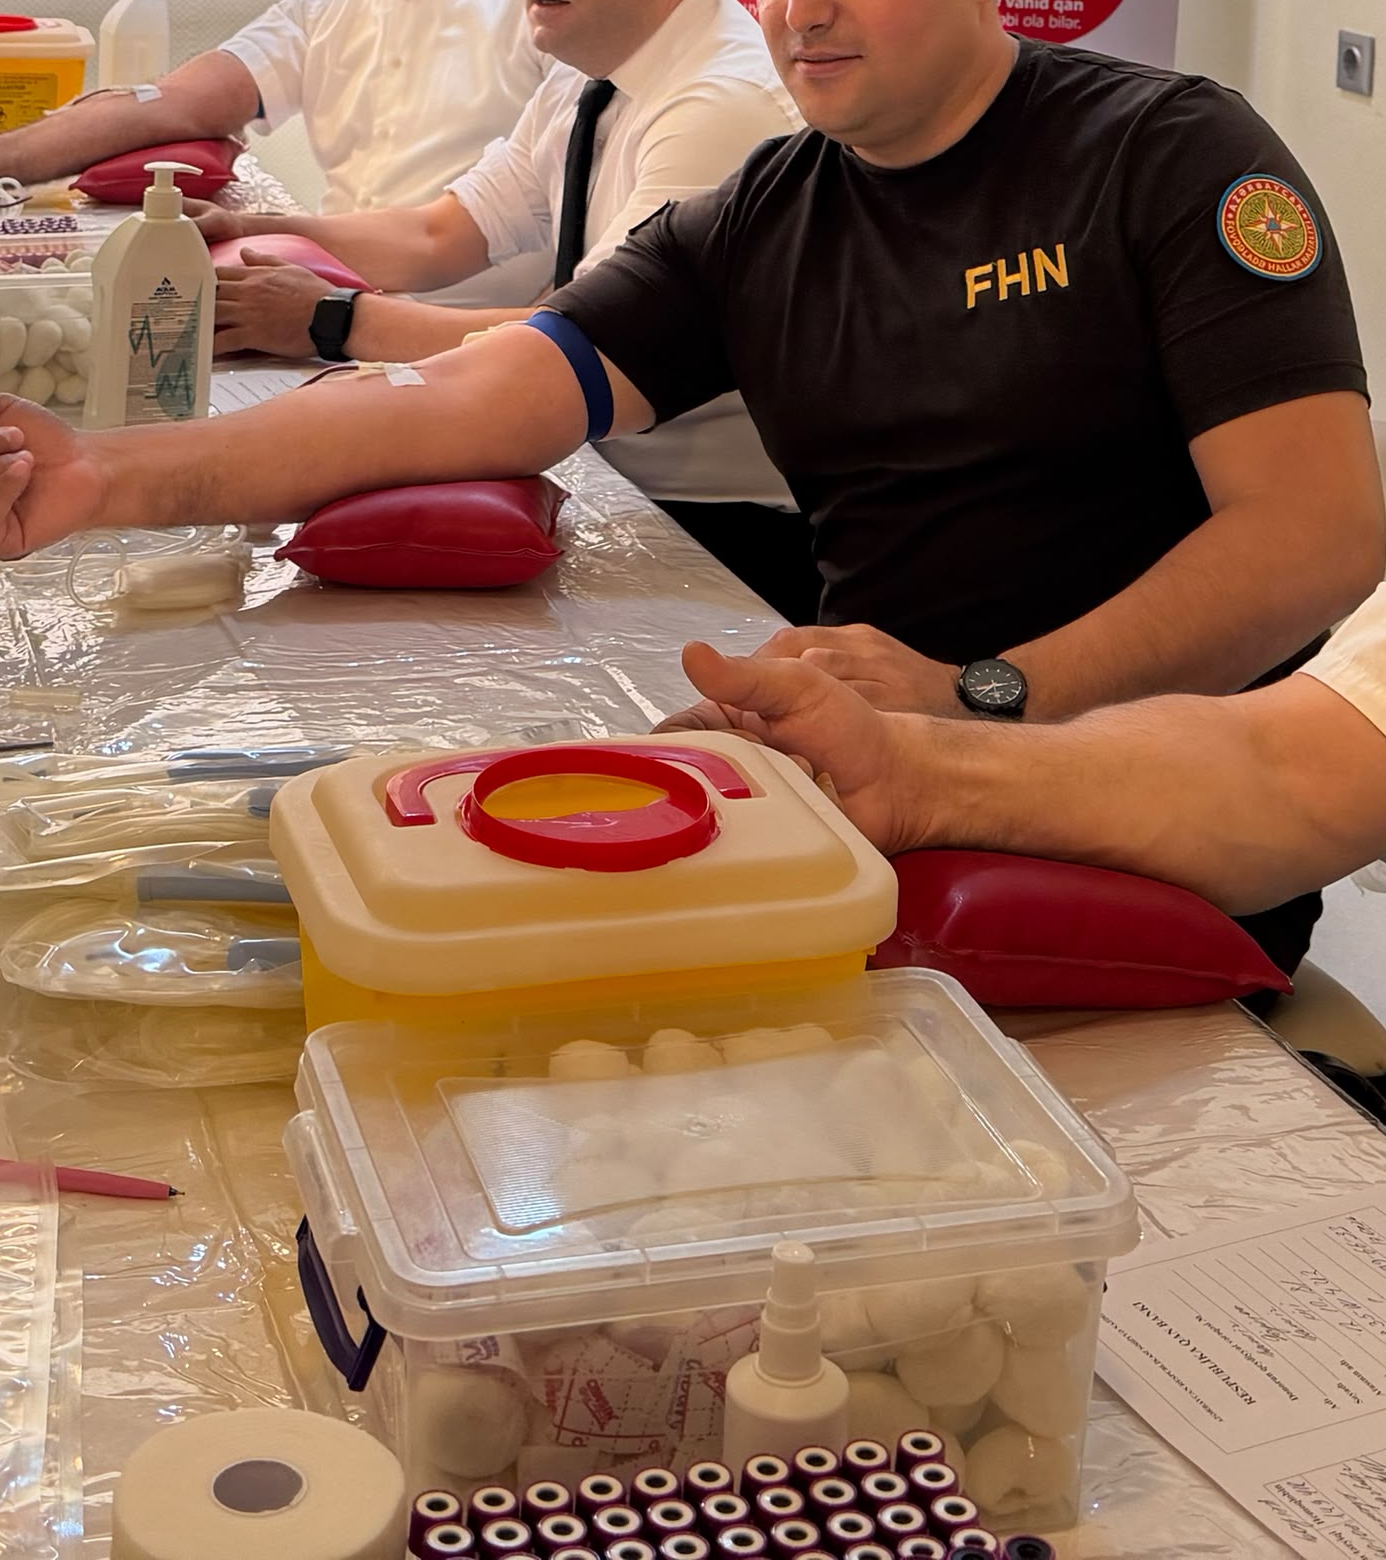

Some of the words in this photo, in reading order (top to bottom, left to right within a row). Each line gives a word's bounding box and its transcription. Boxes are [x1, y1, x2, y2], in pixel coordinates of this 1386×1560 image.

[1053, 0, 1084, 14] qan
[1022, 14, 1045, 28] ola
[1048, 15, 1082, 30] bilər.
[965, 244, 1070, 309] FHN
[1133, 1302, 1168, 1327] BANKI
[1168, 1328, 1190, 1346] QAN
[1190, 1347, 1256, 1405] RESPUBLİKA
